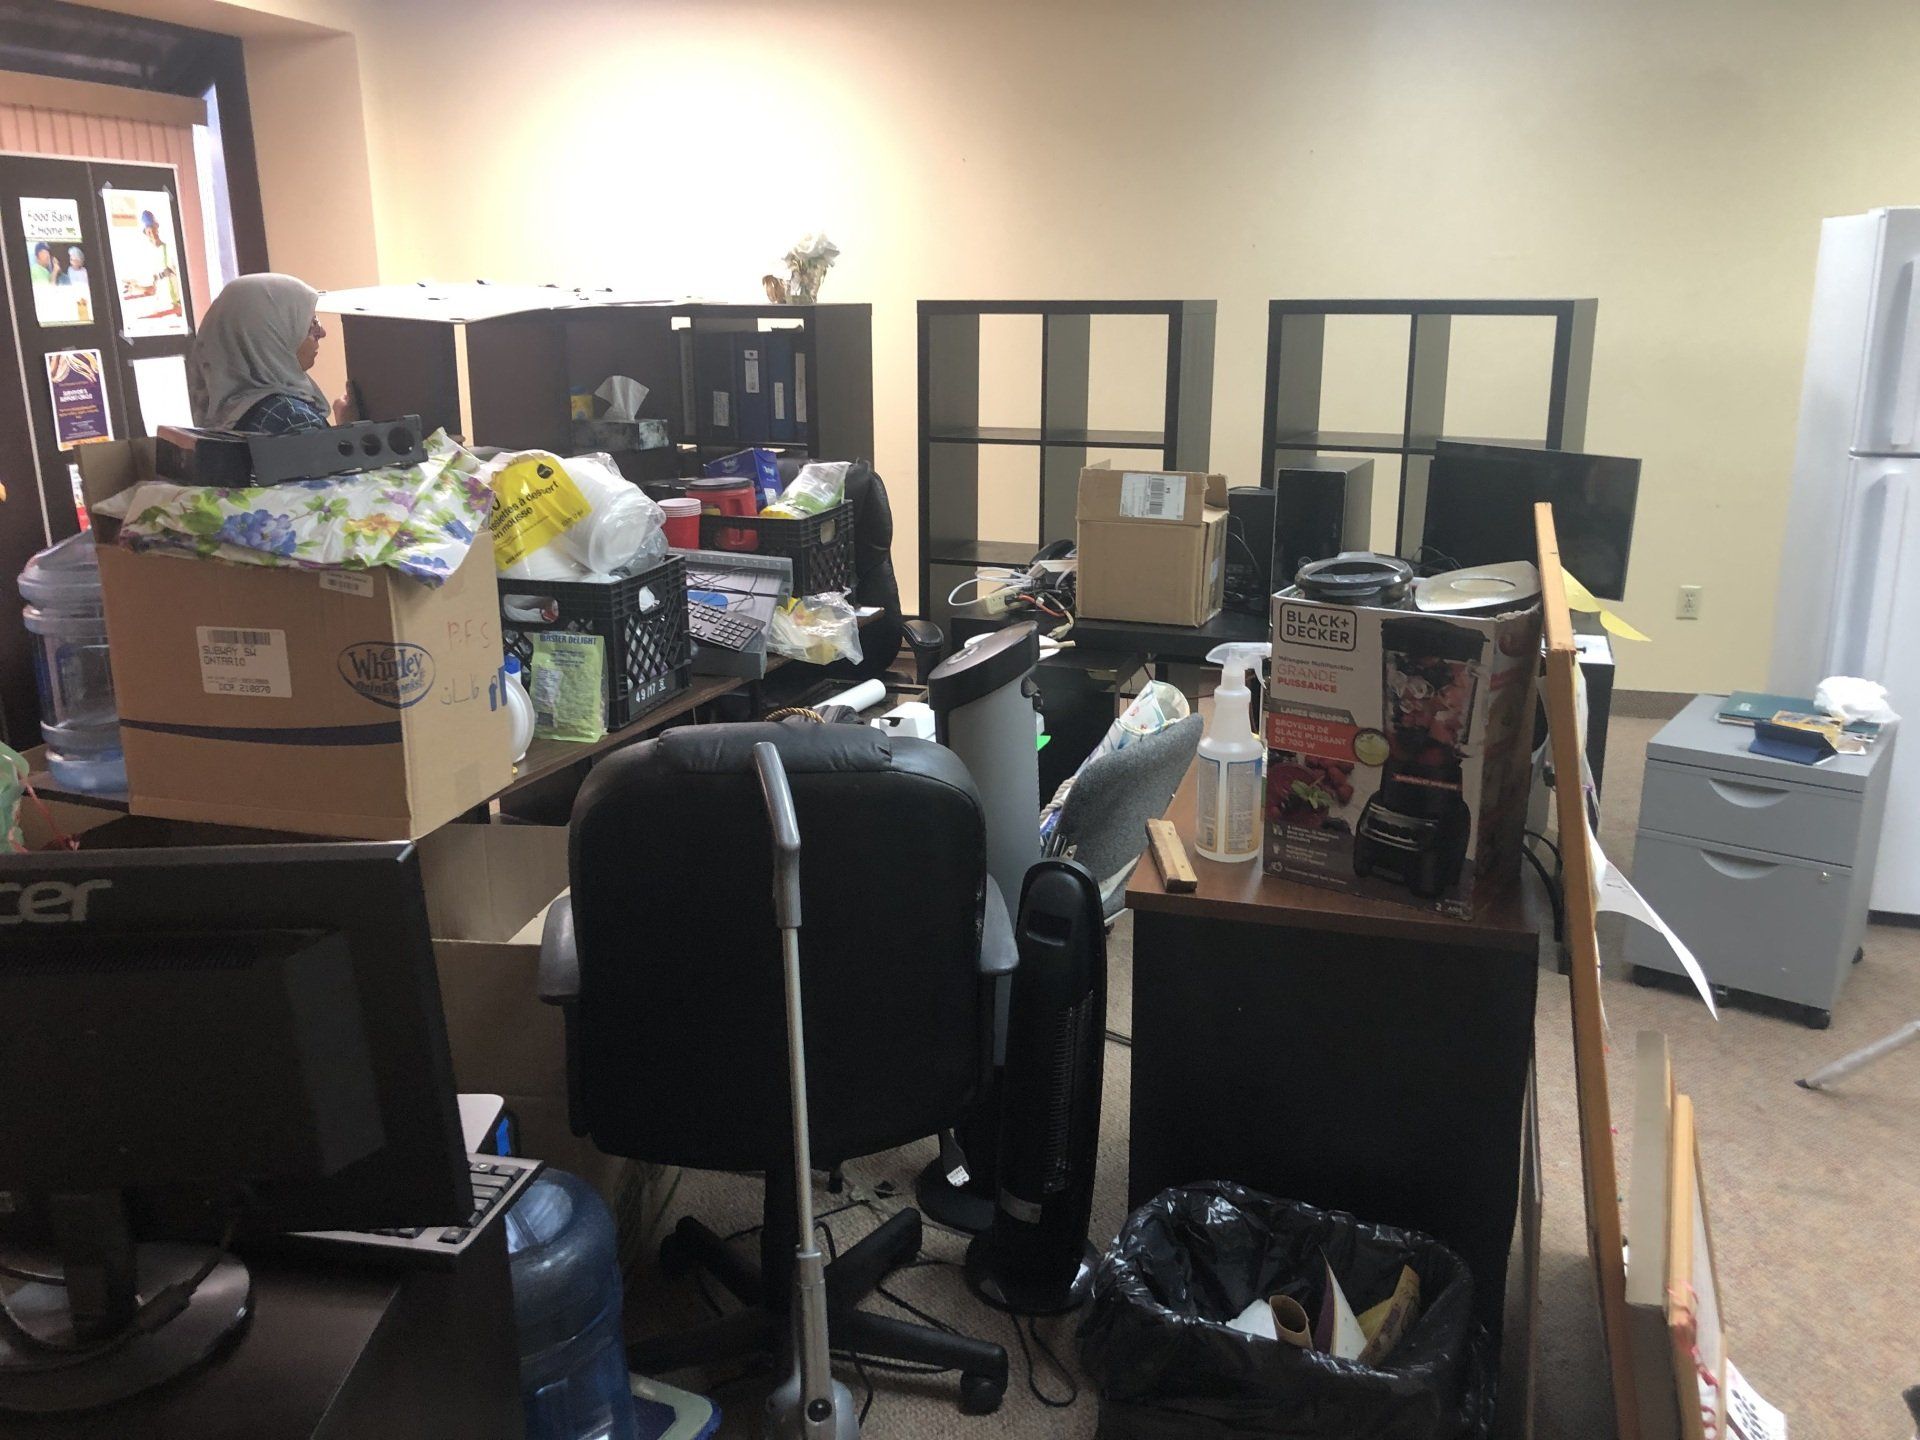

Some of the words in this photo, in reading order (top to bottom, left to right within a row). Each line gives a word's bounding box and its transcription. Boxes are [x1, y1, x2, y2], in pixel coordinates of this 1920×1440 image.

[502, 506, 533, 535] mousse
[1286, 610, 1349, 628] BLACK+
[569, 636, 596, 645] DELIGHT
[1286, 624, 1350, 643] DECKER
[203, 655, 246, 667] ONTARIO
[348, 649, 423, 680] Whirley
[1278, 664, 1337, 683] GRANDE
[1278, 677, 1337, 694] PUISSANCE
